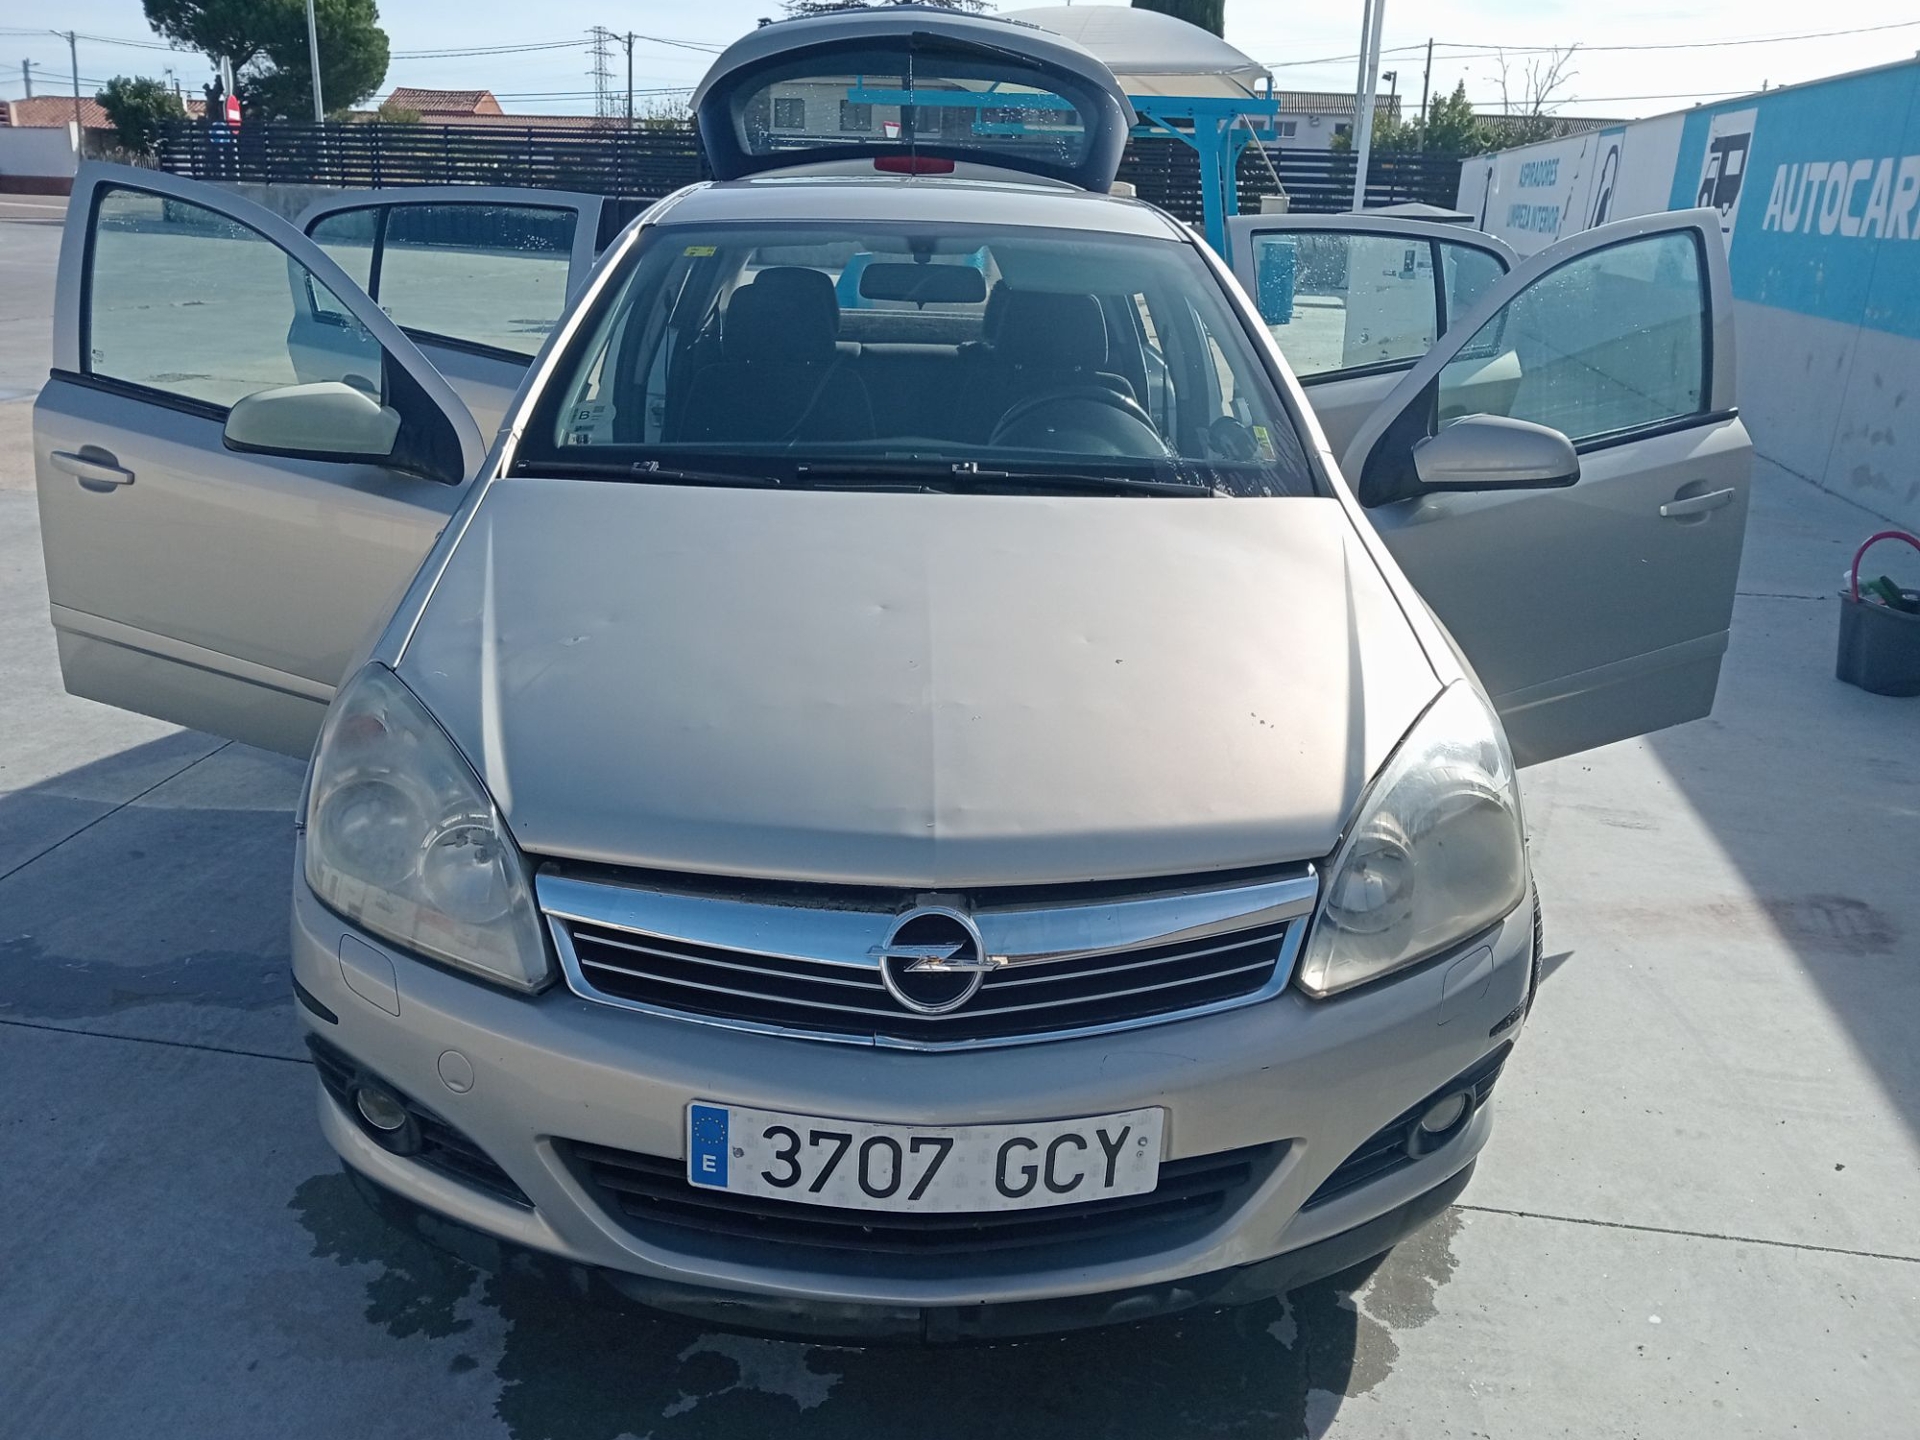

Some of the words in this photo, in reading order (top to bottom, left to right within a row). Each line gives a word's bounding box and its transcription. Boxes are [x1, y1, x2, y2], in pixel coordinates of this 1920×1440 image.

[1762, 154, 1920, 240] AUTOCAR
[703, 1154, 716, 1173] E
[760, 1125, 954, 1200] 3707
[994, 1125, 1131, 1198] GCY
